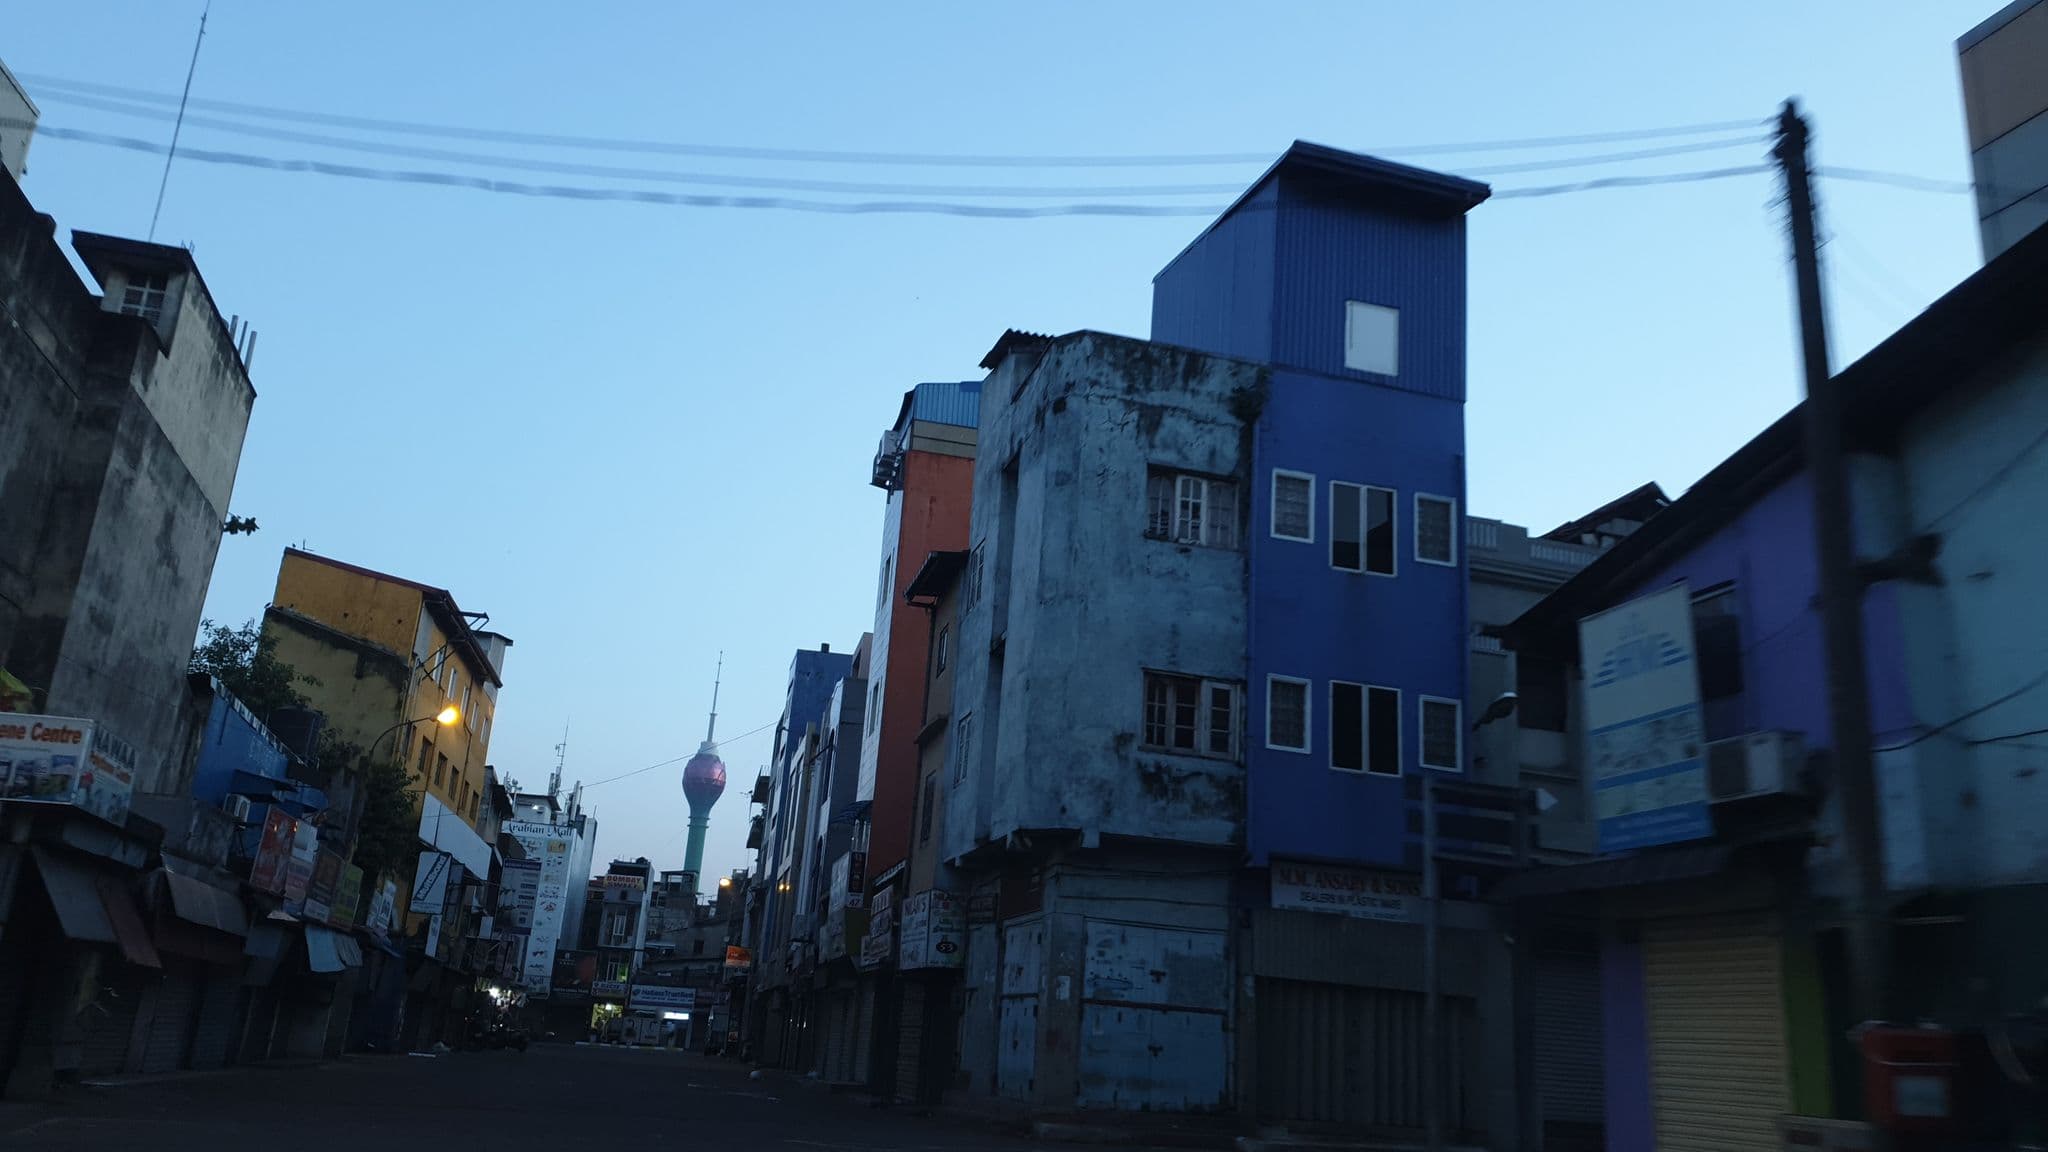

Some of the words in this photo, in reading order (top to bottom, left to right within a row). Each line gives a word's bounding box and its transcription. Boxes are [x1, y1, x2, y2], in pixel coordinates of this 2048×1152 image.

[32, 722, 82, 744] Centre
[508, 823, 545, 835] Arabian
[547, 826, 572, 838] Mall
[607, 875, 642, 884] BOMBAY
